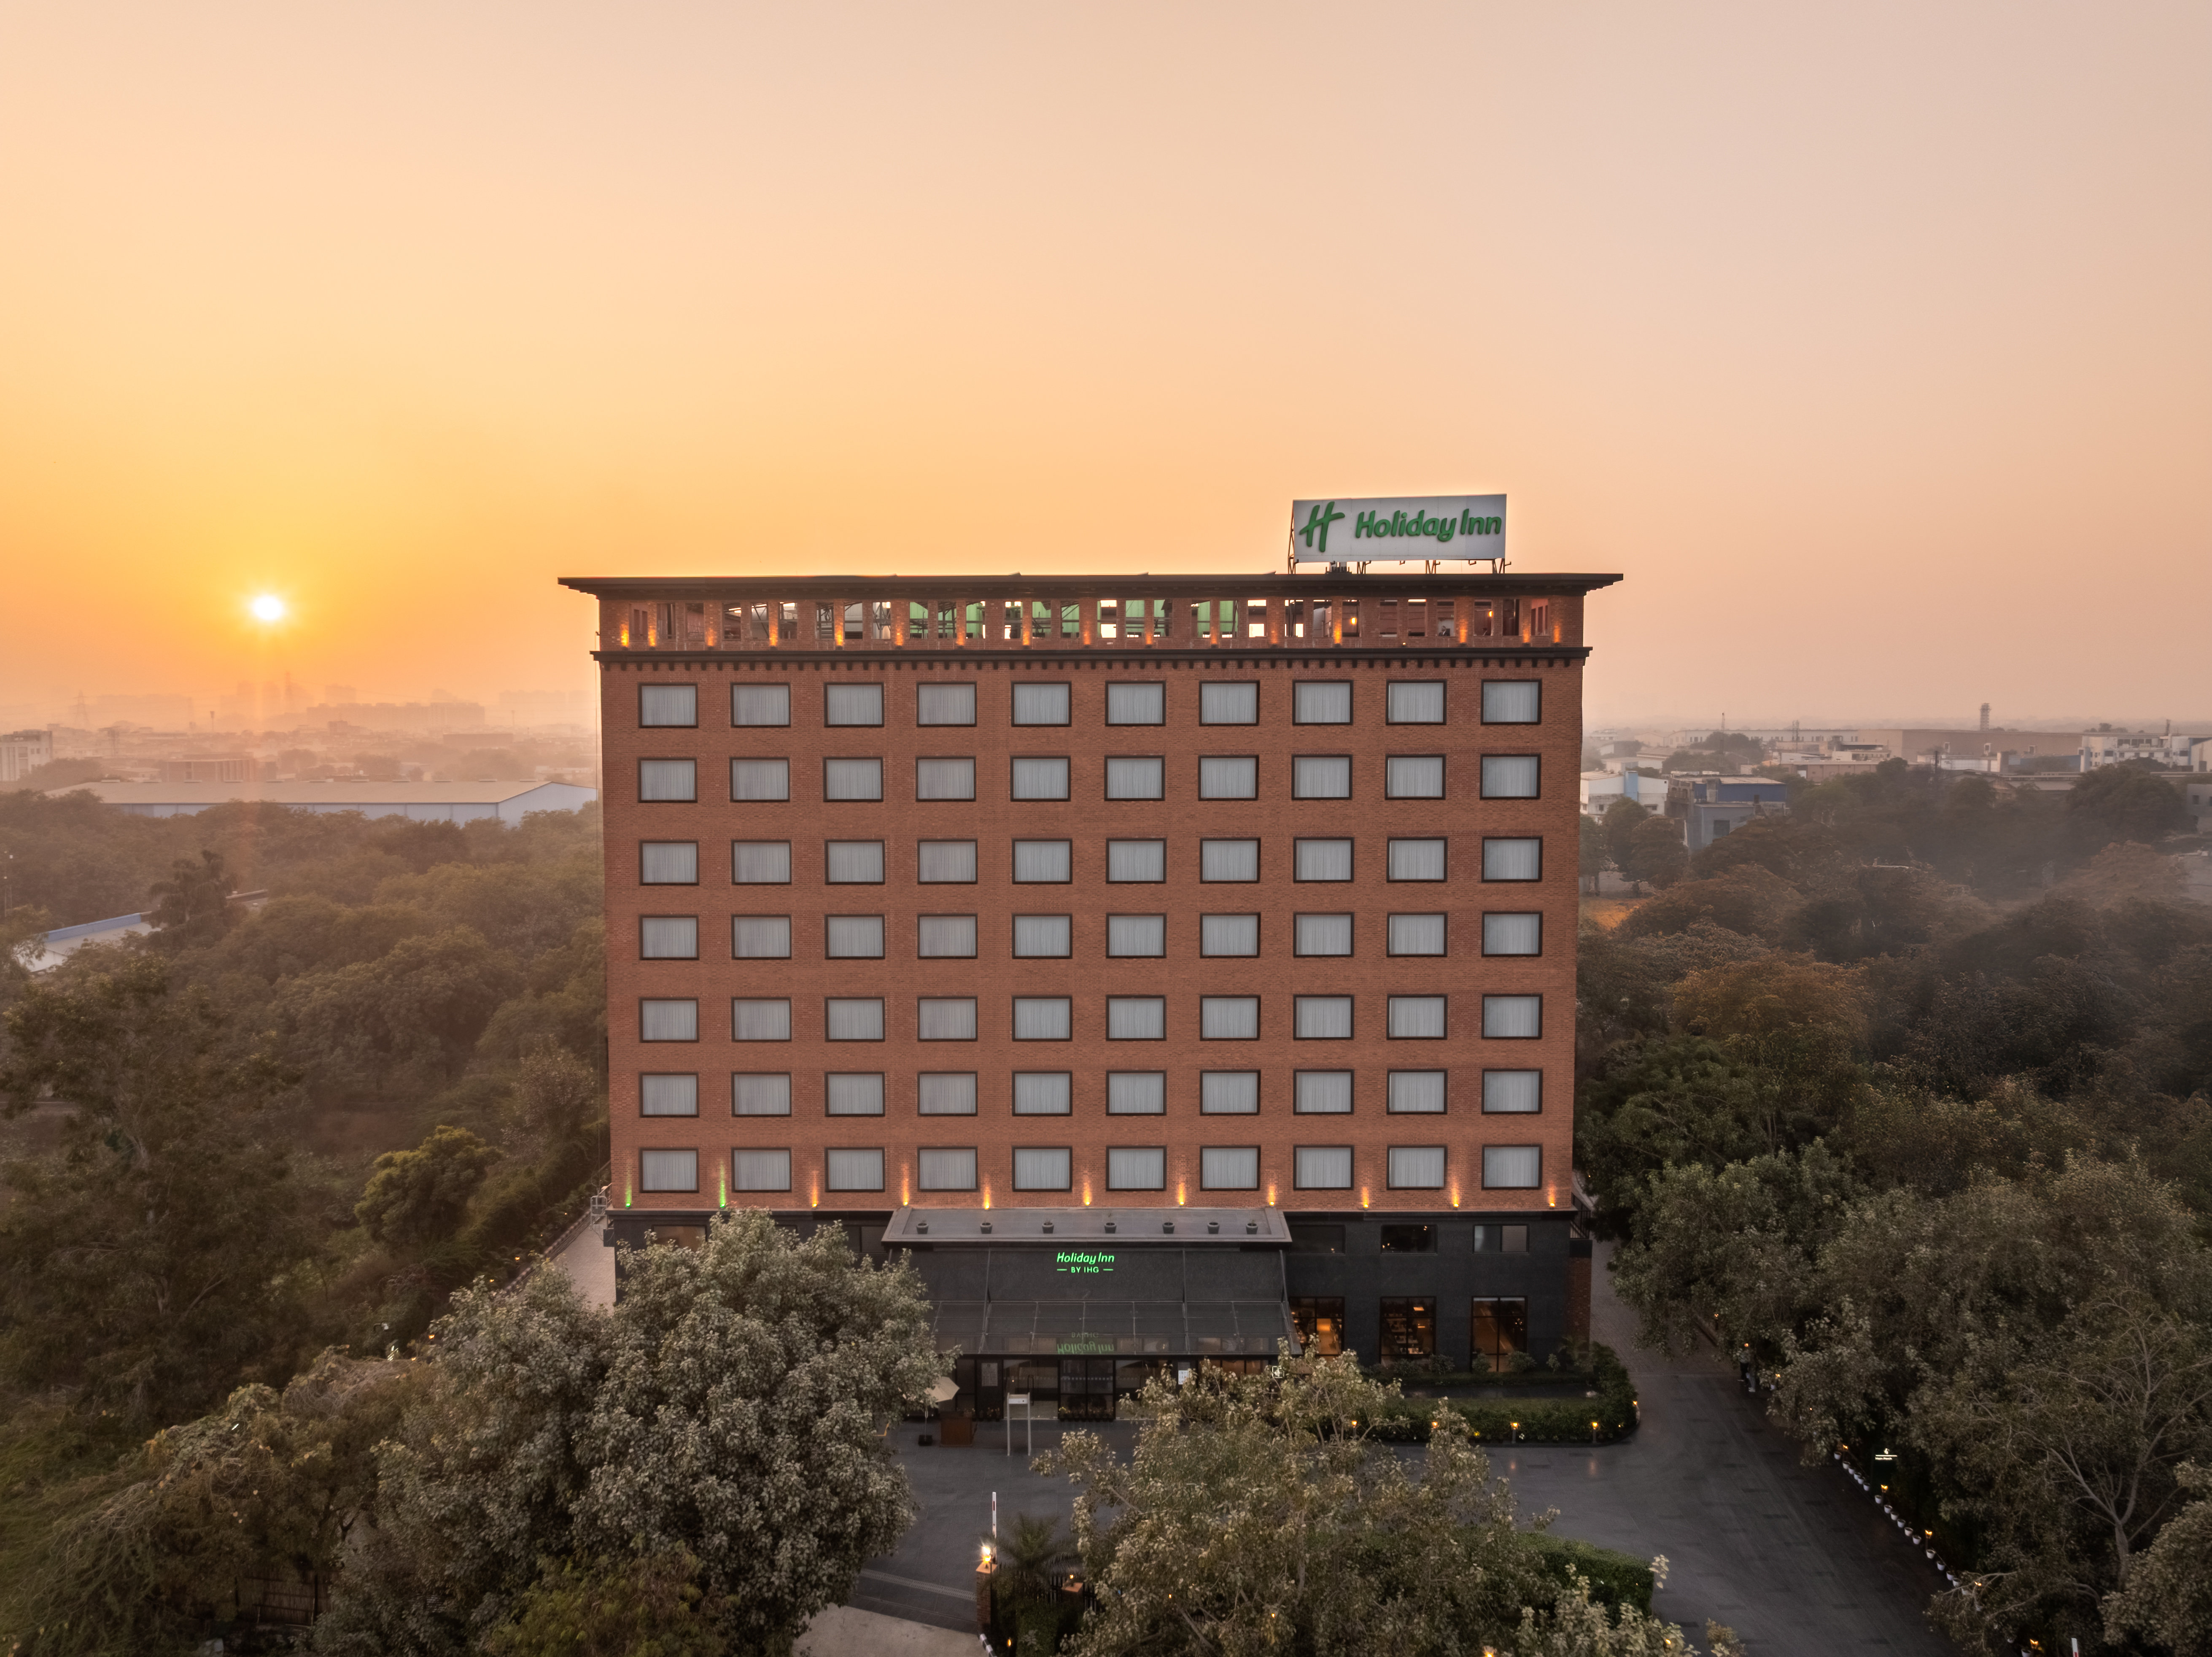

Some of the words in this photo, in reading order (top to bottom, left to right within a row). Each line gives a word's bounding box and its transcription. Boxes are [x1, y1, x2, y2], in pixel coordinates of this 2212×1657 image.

[1355, 509, 1457, 542] Holiday
[1460, 508, 1502, 535] Inn
[1056, 1252, 1097, 1265] Holiday
[1098, 1252, 1115, 1263] Inn
